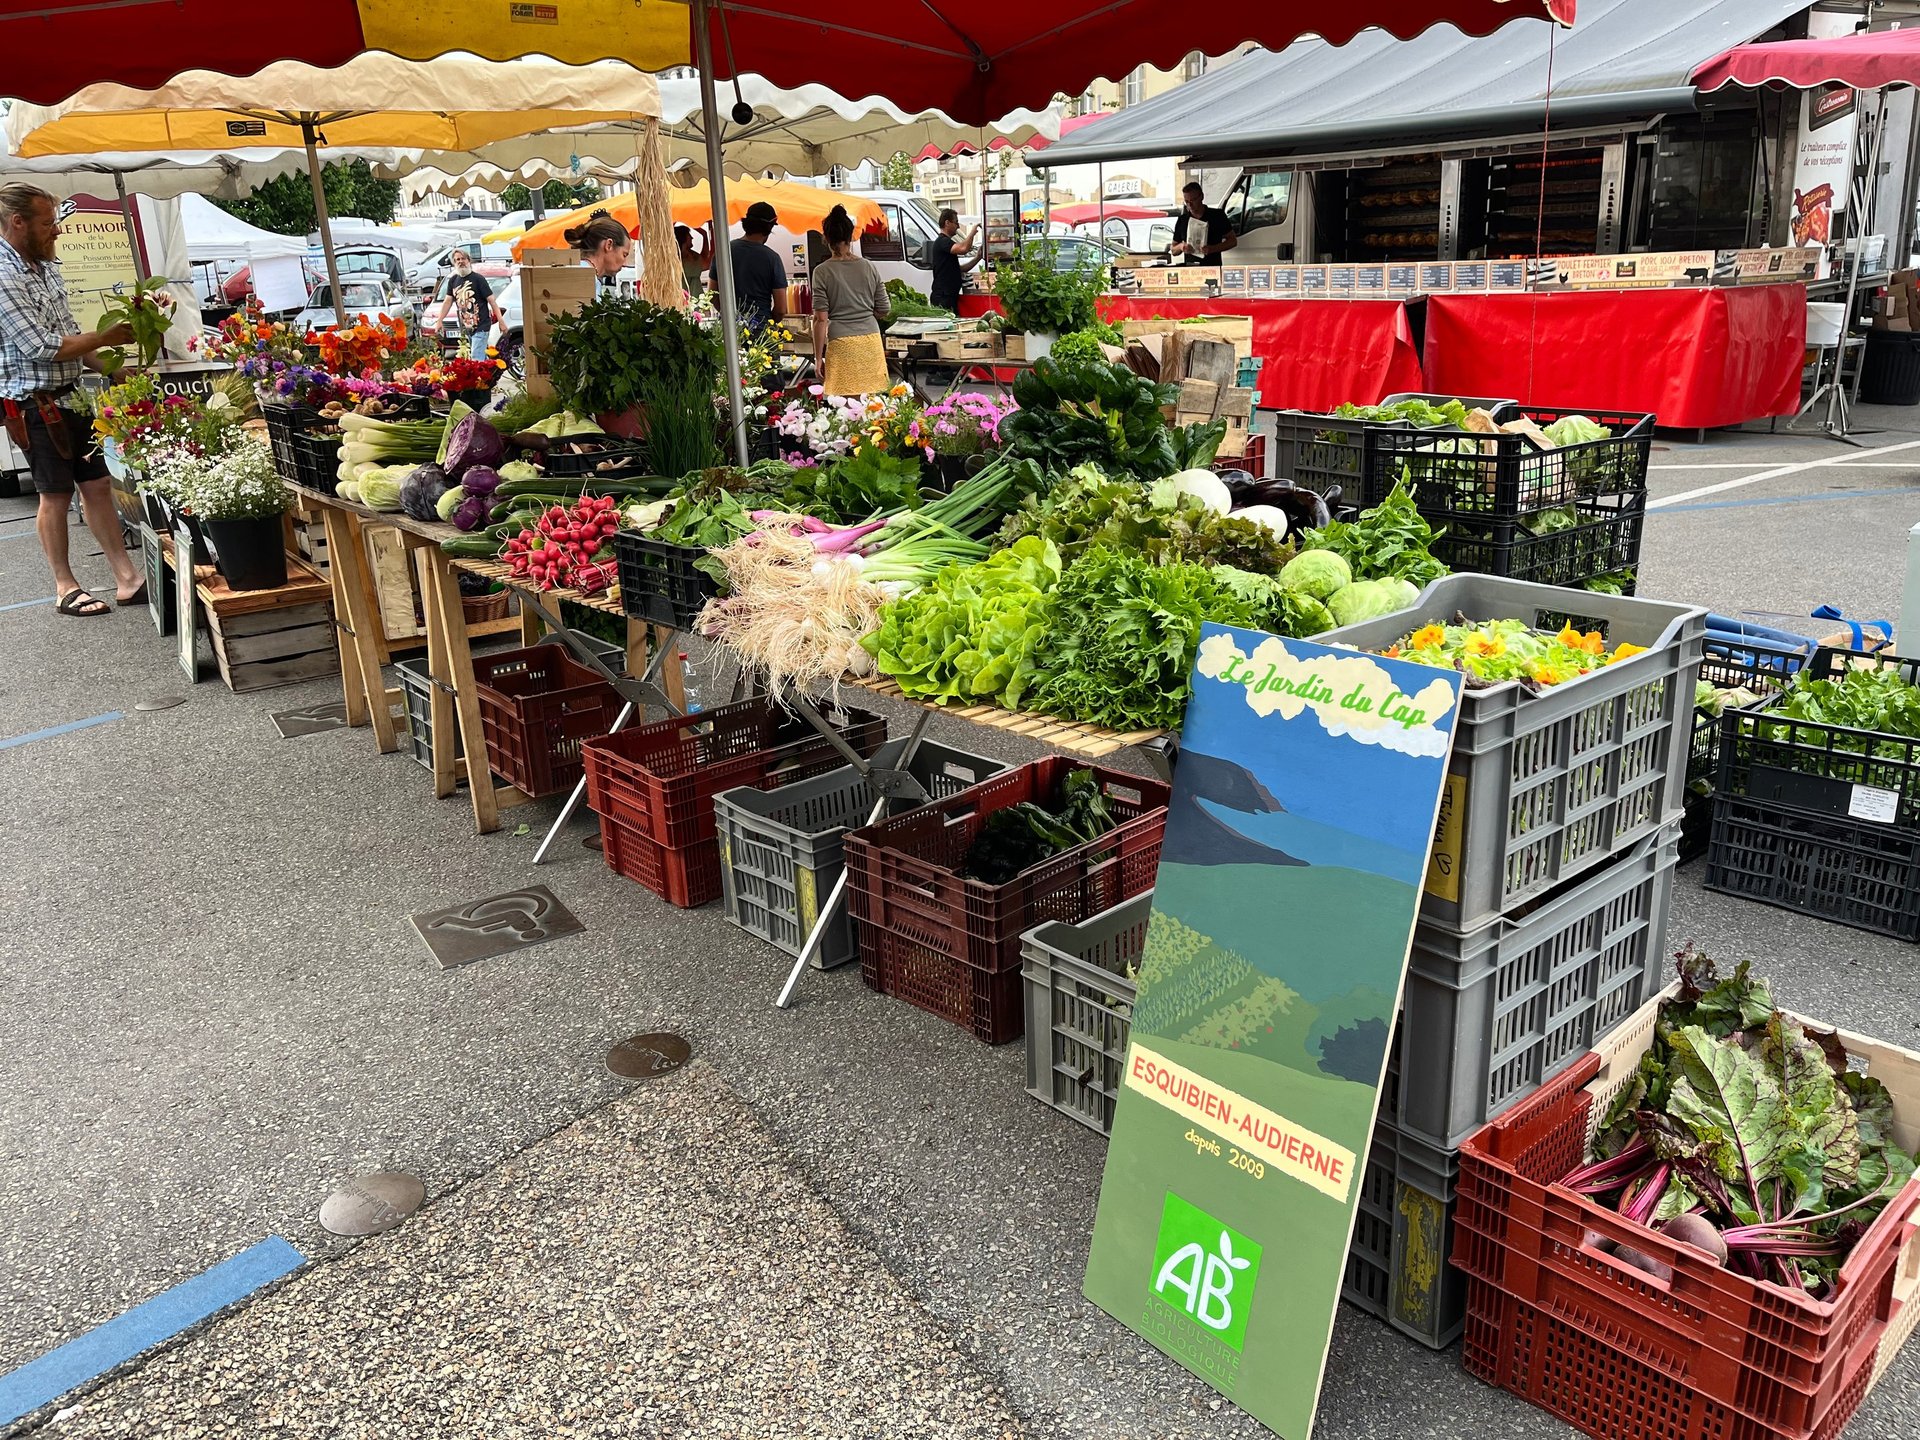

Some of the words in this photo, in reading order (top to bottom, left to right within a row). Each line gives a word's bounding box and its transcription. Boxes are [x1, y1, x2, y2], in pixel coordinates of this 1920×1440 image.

[1800, 142, 1807, 152] Le
[1826, 140, 1848, 154] complice
[1803, 156, 1811, 166] de
[1107, 181, 1139, 193] GALERIE
[60, 223, 73, 235] LE
[75, 222, 128, 235] FUMOIR
[62, 242, 96, 251] POINTE
[97, 241, 113, 250] DU
[114, 240, 131, 249] RAZ
[83, 254, 112, 262] Poissons
[1557, 259, 1581, 270] POULET
[1583, 258, 1612, 269] FERMIER
[1640, 256, 1658, 266] PORC
[1678, 254, 1707, 265] BRETON
[1572, 270, 1596, 279] BRETON
[1219, 655, 1254, 685] Le
[1253, 663, 1334, 704] Jardin
[1340, 683, 1374, 713] du
[1378, 691, 1426, 730] Cap
[1132, 1055, 1345, 1185] ESQUIBIEN-AUDIERNE
[1184, 1128, 1222, 1157] depuis
[1228, 1148, 1265, 1180] 2009
[1155, 1242, 1234, 1330] AB
[1144, 1297, 1240, 1371] AGRICULTURE
[1141, 1311, 1236, 1387] BIOLOGIQUE
